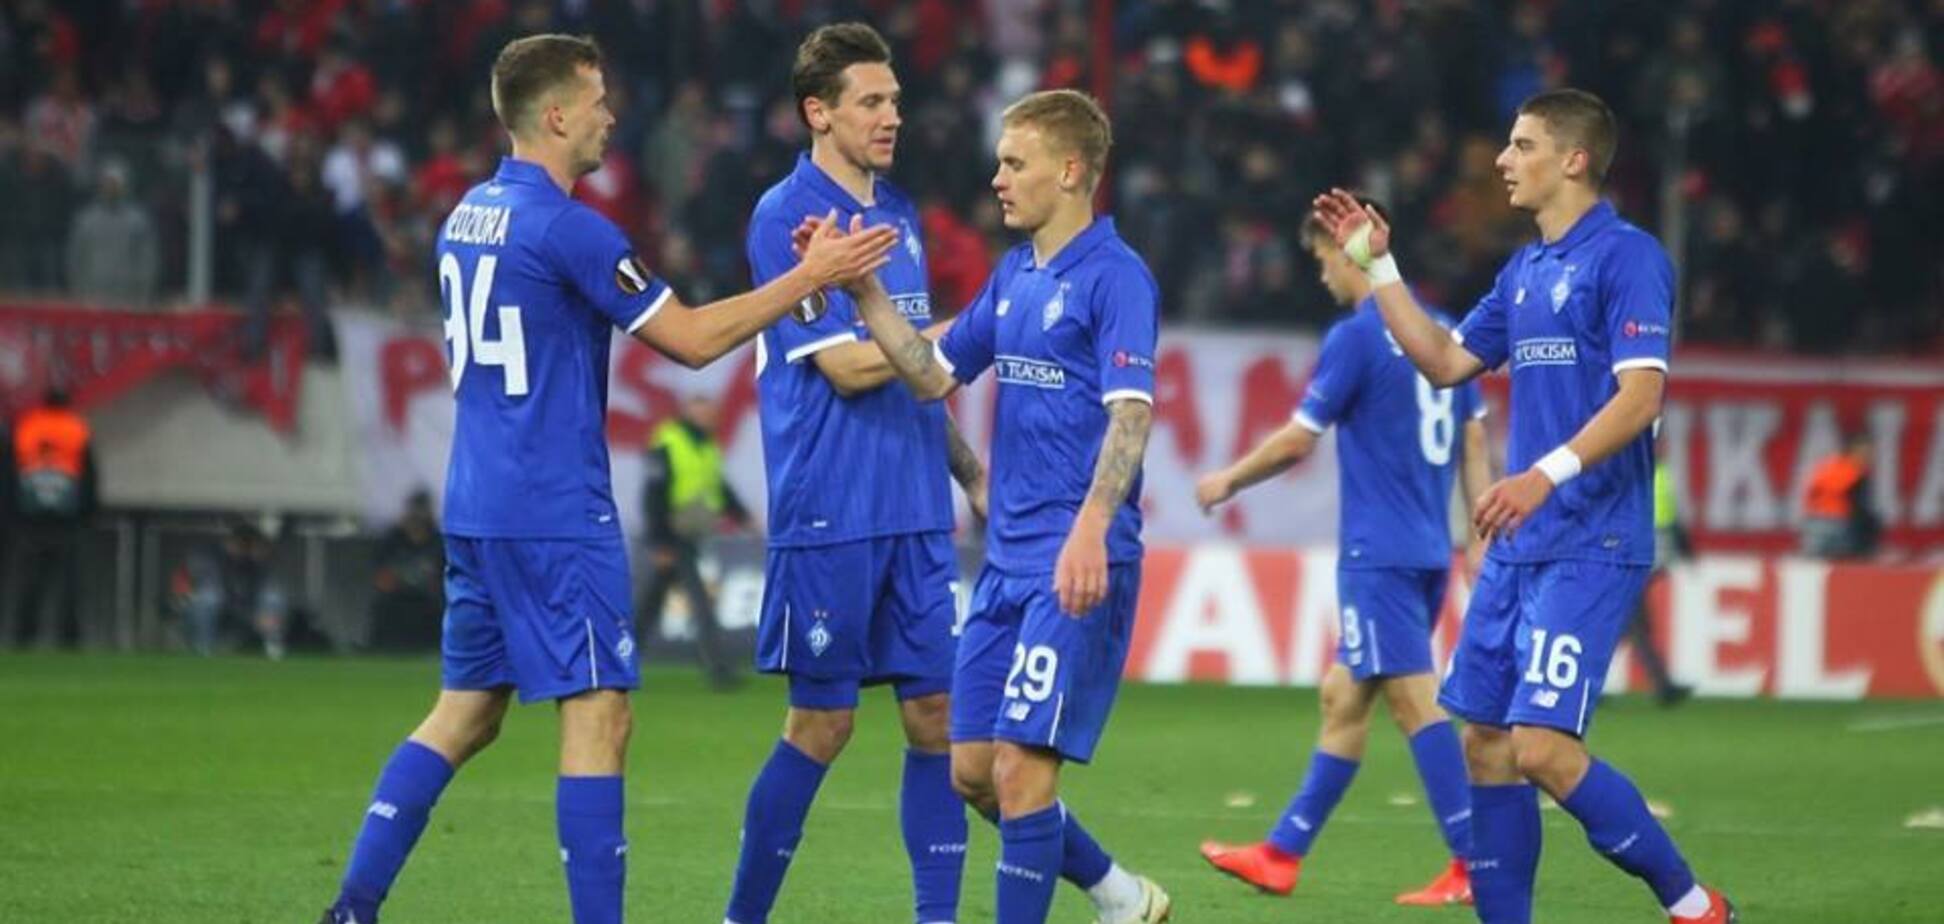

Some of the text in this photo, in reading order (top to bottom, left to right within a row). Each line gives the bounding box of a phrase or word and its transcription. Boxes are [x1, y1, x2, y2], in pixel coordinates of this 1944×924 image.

[439, 253, 529, 396] 94
[1415, 370, 1454, 467] 8
[1343, 606, 1363, 650] 8
[1003, 641, 1058, 702] 29
[1524, 629, 1582, 689] 16
